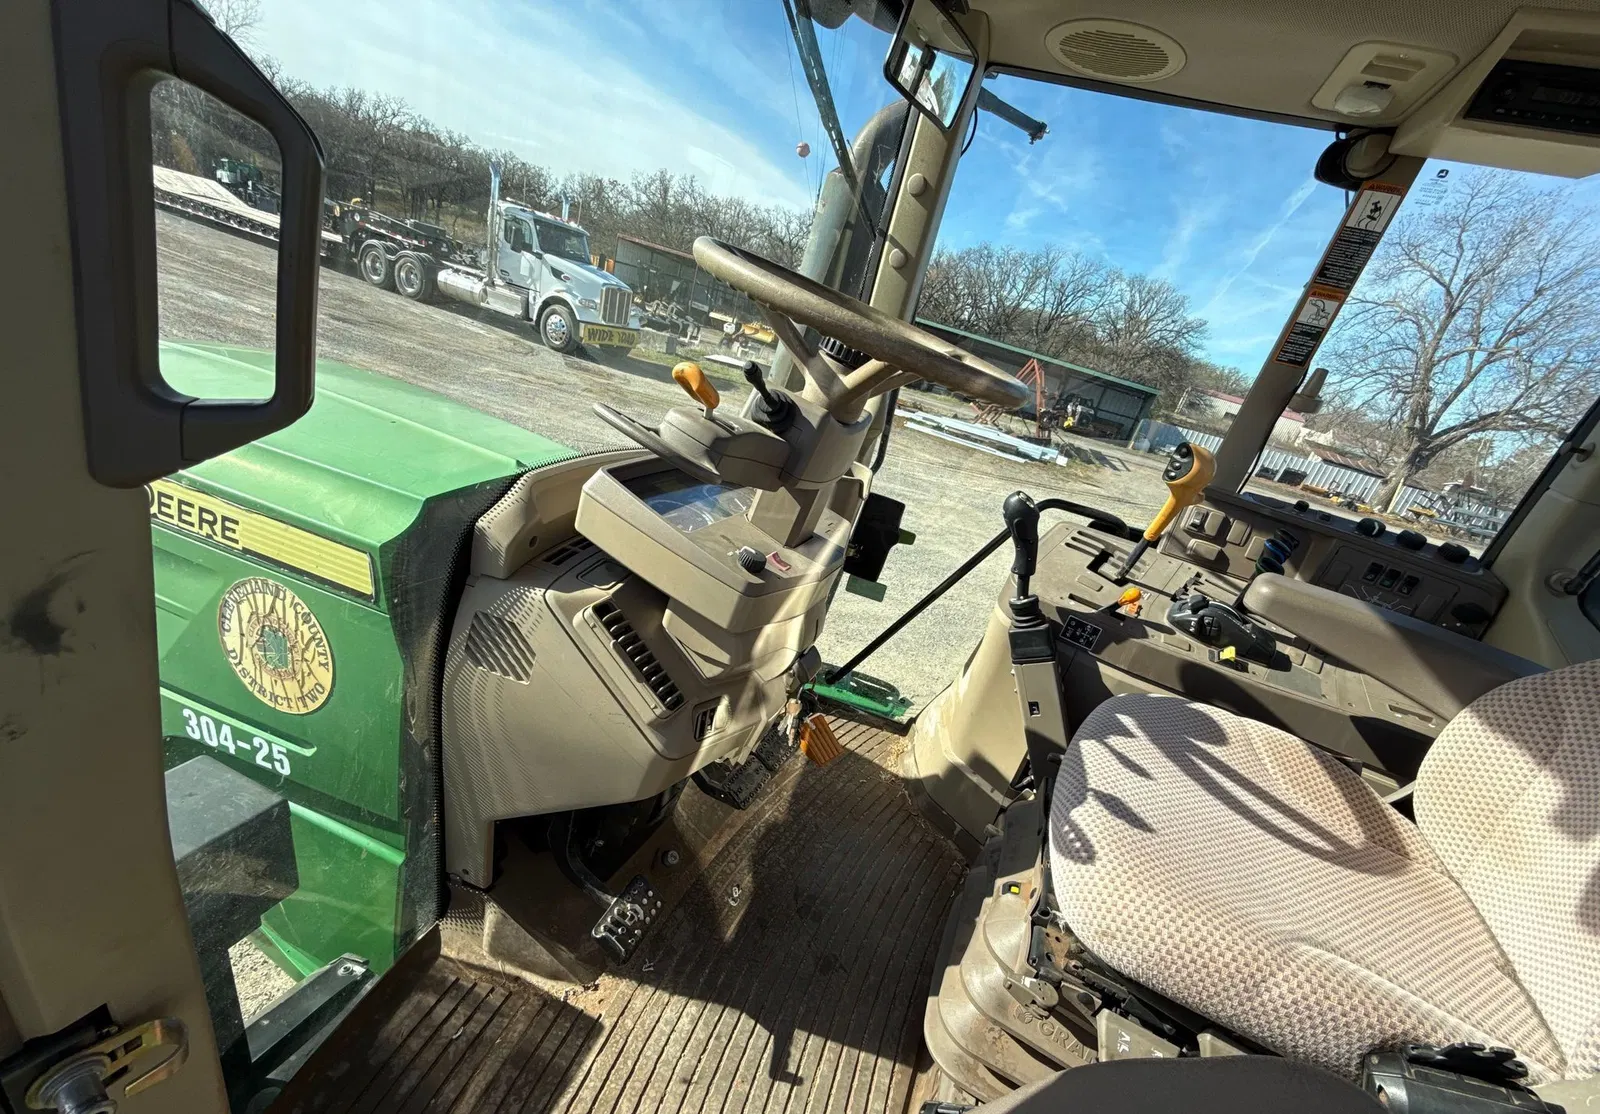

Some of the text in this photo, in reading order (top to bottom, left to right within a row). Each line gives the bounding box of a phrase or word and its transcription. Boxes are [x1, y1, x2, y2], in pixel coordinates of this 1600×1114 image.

[587, 328, 614, 342] WIDE
[220, 581, 287, 634] CLEVELAND
[292, 601, 330, 673] COUNTY
[226, 647, 326, 709] DISTRICT TWO
[182, 708, 291, 776] 304-25
